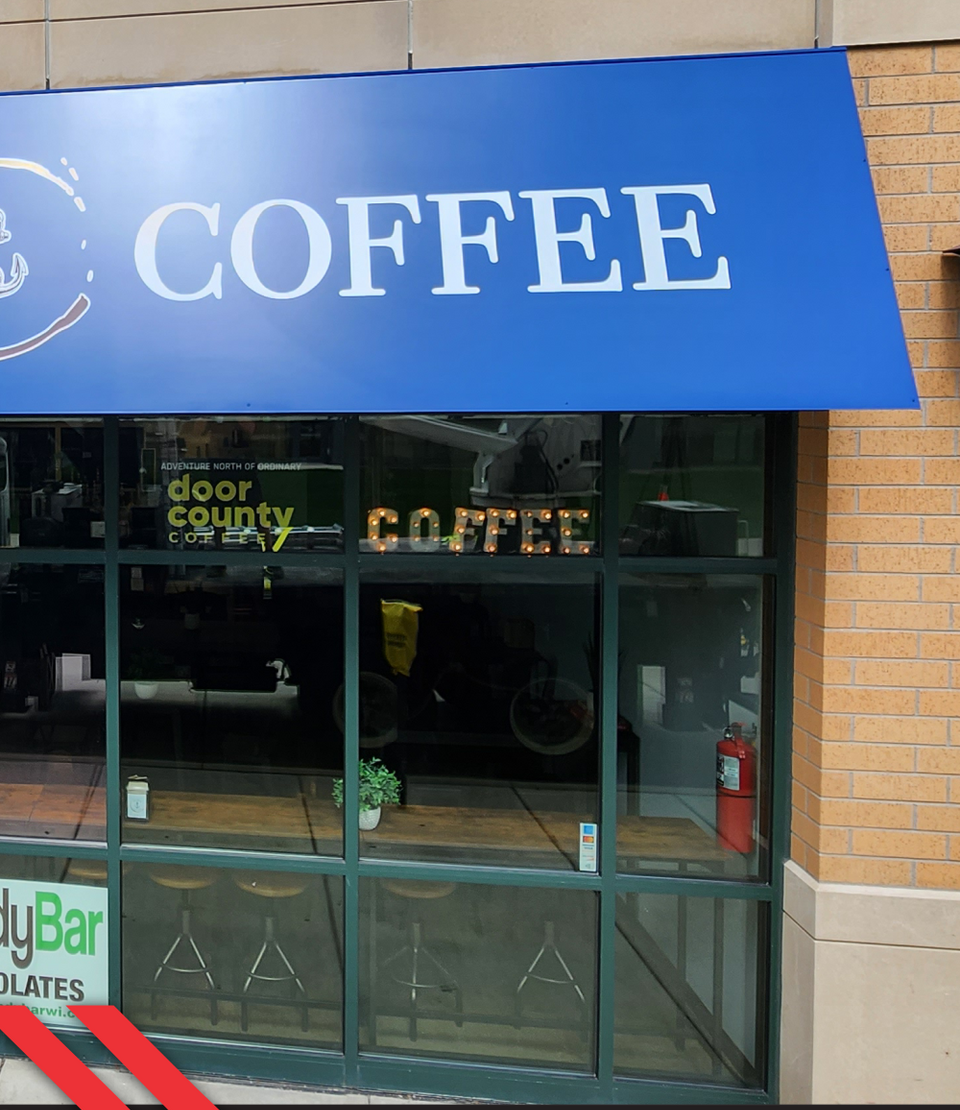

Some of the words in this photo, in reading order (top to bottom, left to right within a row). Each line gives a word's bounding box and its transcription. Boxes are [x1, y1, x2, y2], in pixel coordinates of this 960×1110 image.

[133, 182, 732, 303] COFFEE
[161, 462, 211, 471] ADVENTURE
[214, 462, 242, 470] NORTH
[245, 462, 255, 470] OF
[257, 462, 302, 471] ORDINARY
[167, 473, 253, 502] door
[167, 502, 295, 552] county
[168, 532, 267, 544] COFFEE
[367, 506, 591, 556] COFFEE
